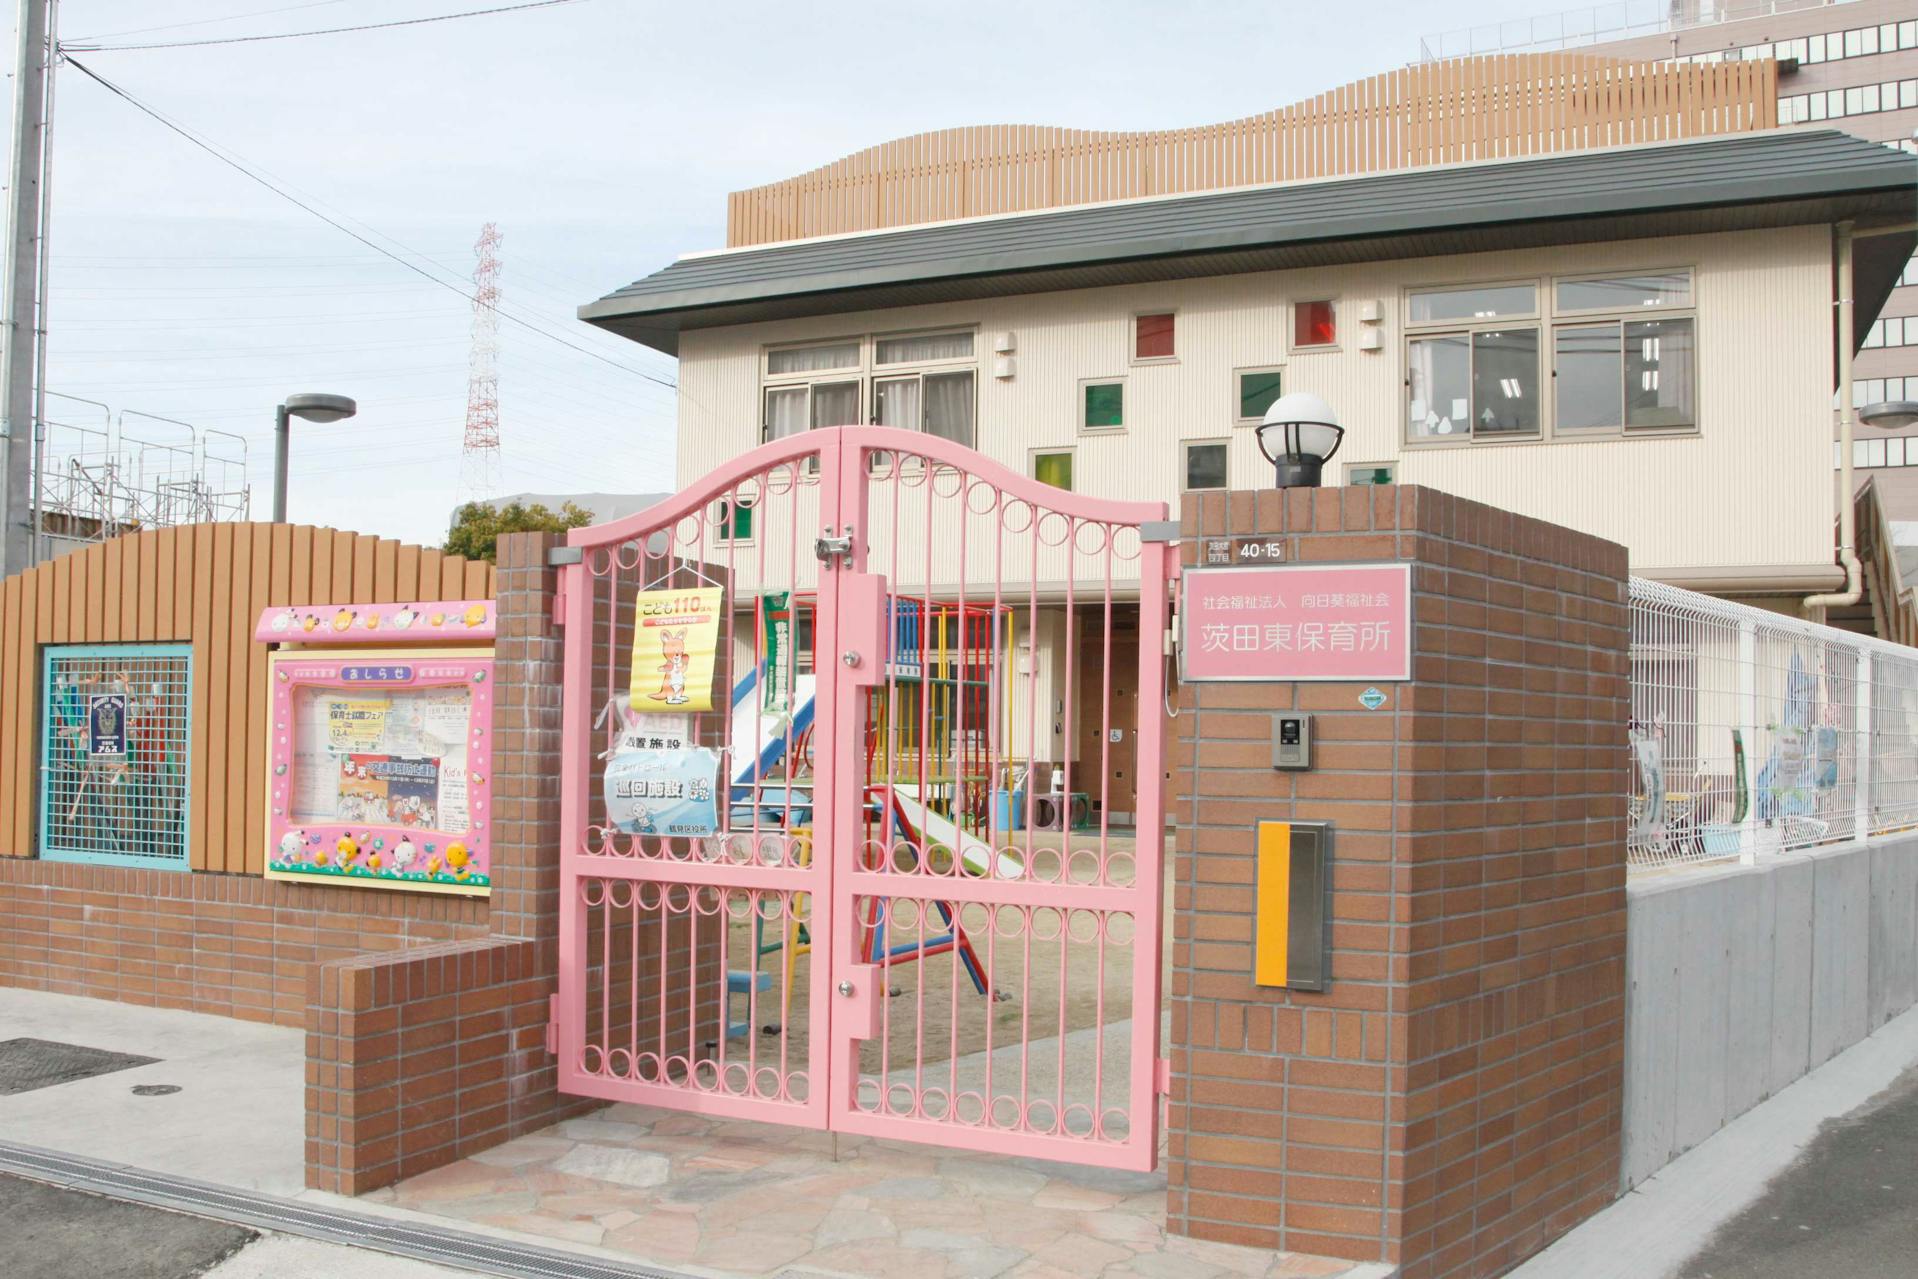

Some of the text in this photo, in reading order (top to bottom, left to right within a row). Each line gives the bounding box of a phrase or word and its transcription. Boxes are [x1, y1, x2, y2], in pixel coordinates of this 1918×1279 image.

[1241, 543, 1280, 557] 40-15
[1203, 592, 1390, 609] 社会福祉法人 向日葵福祉会
[1200, 620, 1391, 652] 茨田東保育所
[350, 668, 403, 680] おしらせ
